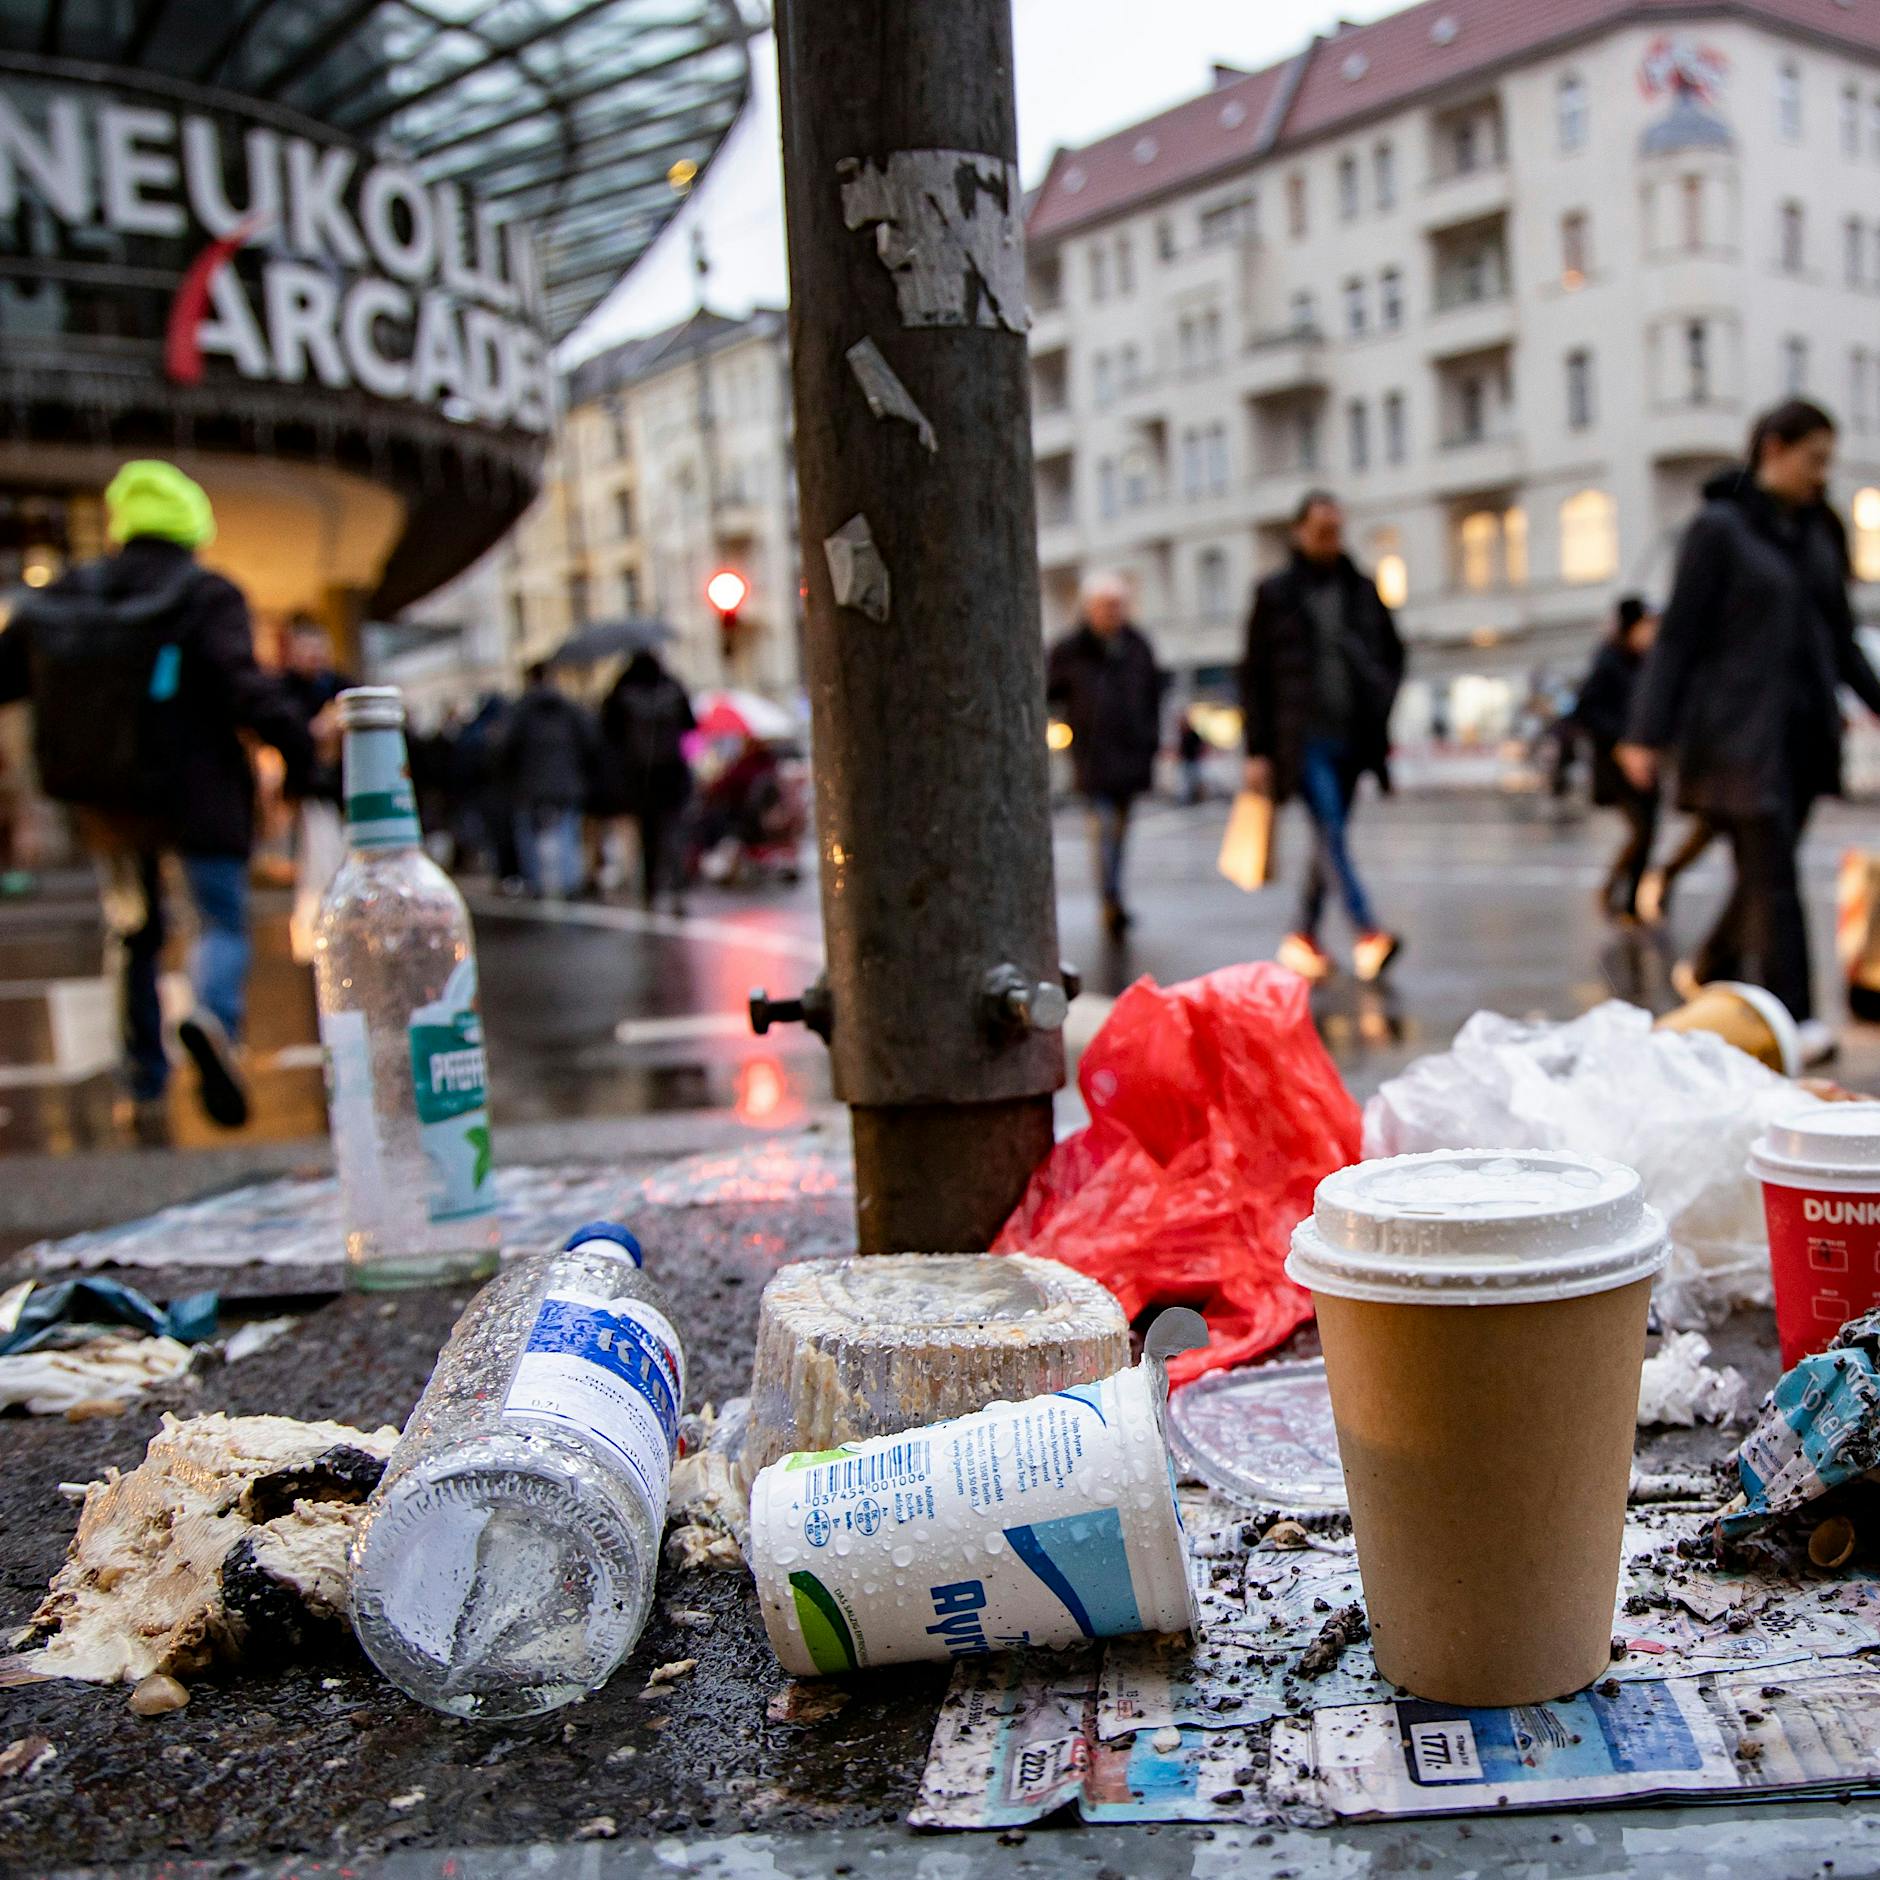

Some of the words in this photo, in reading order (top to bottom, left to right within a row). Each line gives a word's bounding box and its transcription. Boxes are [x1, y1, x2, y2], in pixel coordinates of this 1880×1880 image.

[1062, 1426, 1073, 1474] traditionelles
[1074, 1434, 1083, 1457] Ayran
[1040, 1441, 1051, 1482] erfrischend
[812, 1486, 865, 1507] 037454
[871, 1471, 925, 1493] 001006
[969, 1476, 977, 1486] 50
[970, 1486, 978, 1497] 66
[994, 1475, 1004, 1502] GmbH
[1032, 1478, 1038, 1488] zu
[1056, 1477, 1064, 1489] Art
[982, 1482, 991, 1505] Berlin
[834, 1588, 848, 1605] DAS
[844, 1604, 861, 1630] SALZIG
